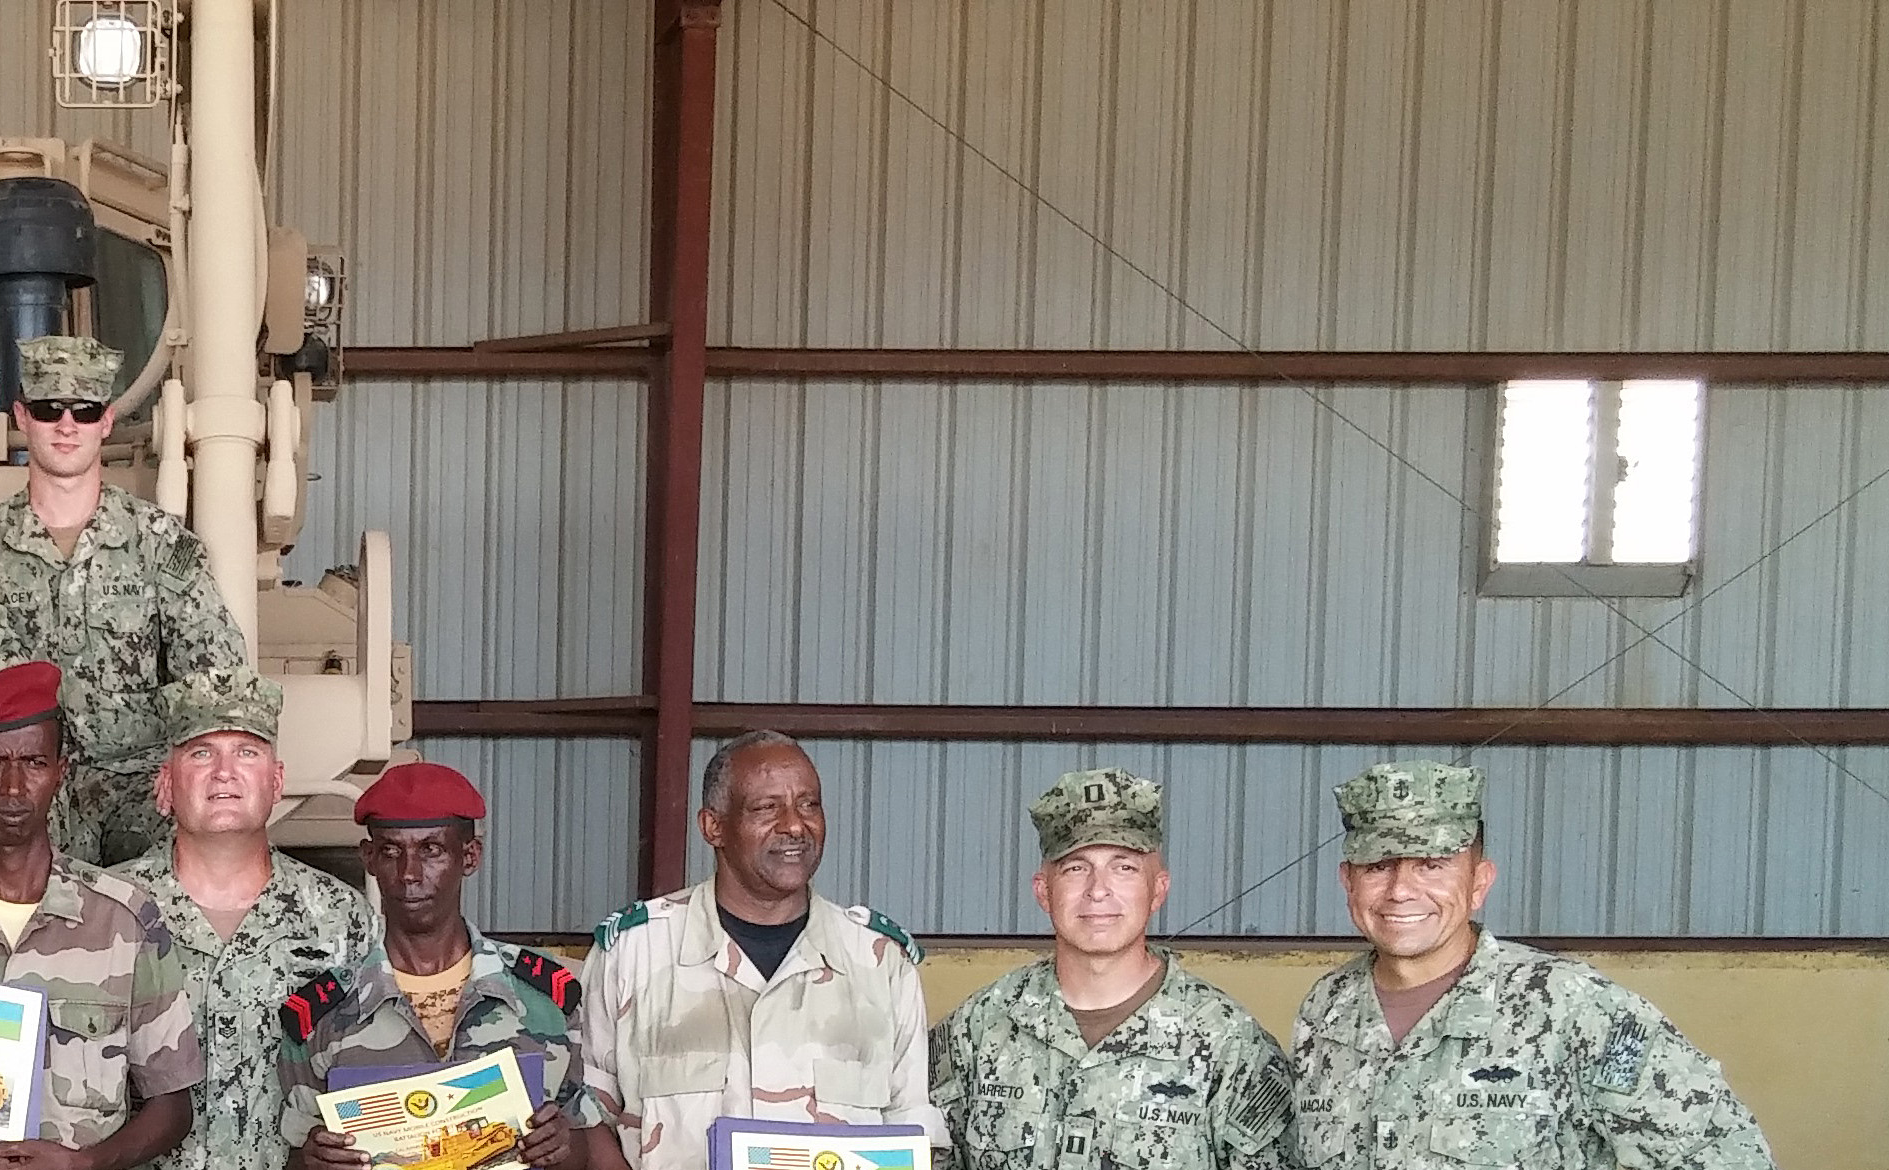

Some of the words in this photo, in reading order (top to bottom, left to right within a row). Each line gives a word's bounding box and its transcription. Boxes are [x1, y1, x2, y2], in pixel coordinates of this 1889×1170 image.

[102, 585, 121, 596] U.S.
[1456, 1093, 1483, 1108] U.S.
[1486, 1093, 1528, 1108] NAVY
[1138, 1105, 1163, 1123] U.S.
[1166, 1109, 1202, 1126] NAVY
